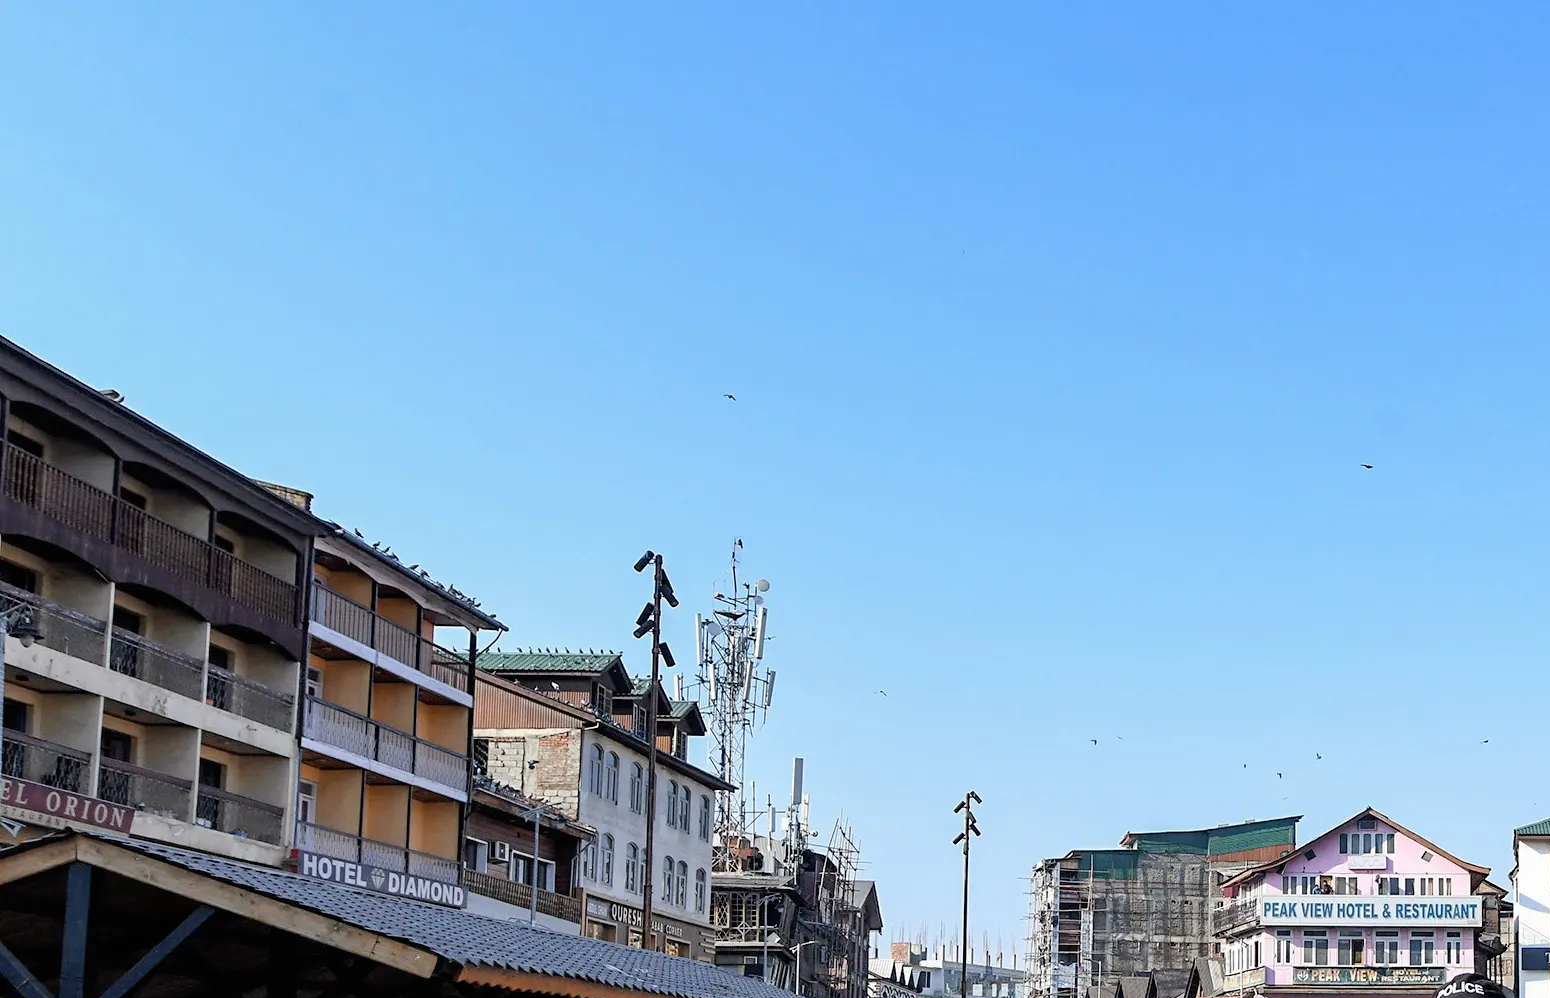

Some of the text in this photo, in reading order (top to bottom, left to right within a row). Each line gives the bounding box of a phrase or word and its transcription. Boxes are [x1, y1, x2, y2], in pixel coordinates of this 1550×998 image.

[46, 792, 125, 827] ORION
[303, 853, 464, 907] HOTEL DIAMOND
[1264, 902, 1478, 919] PEAK VIEW HOTEL & RESTAURANT
[1311, 970, 1378, 982] PEAK VIEW
